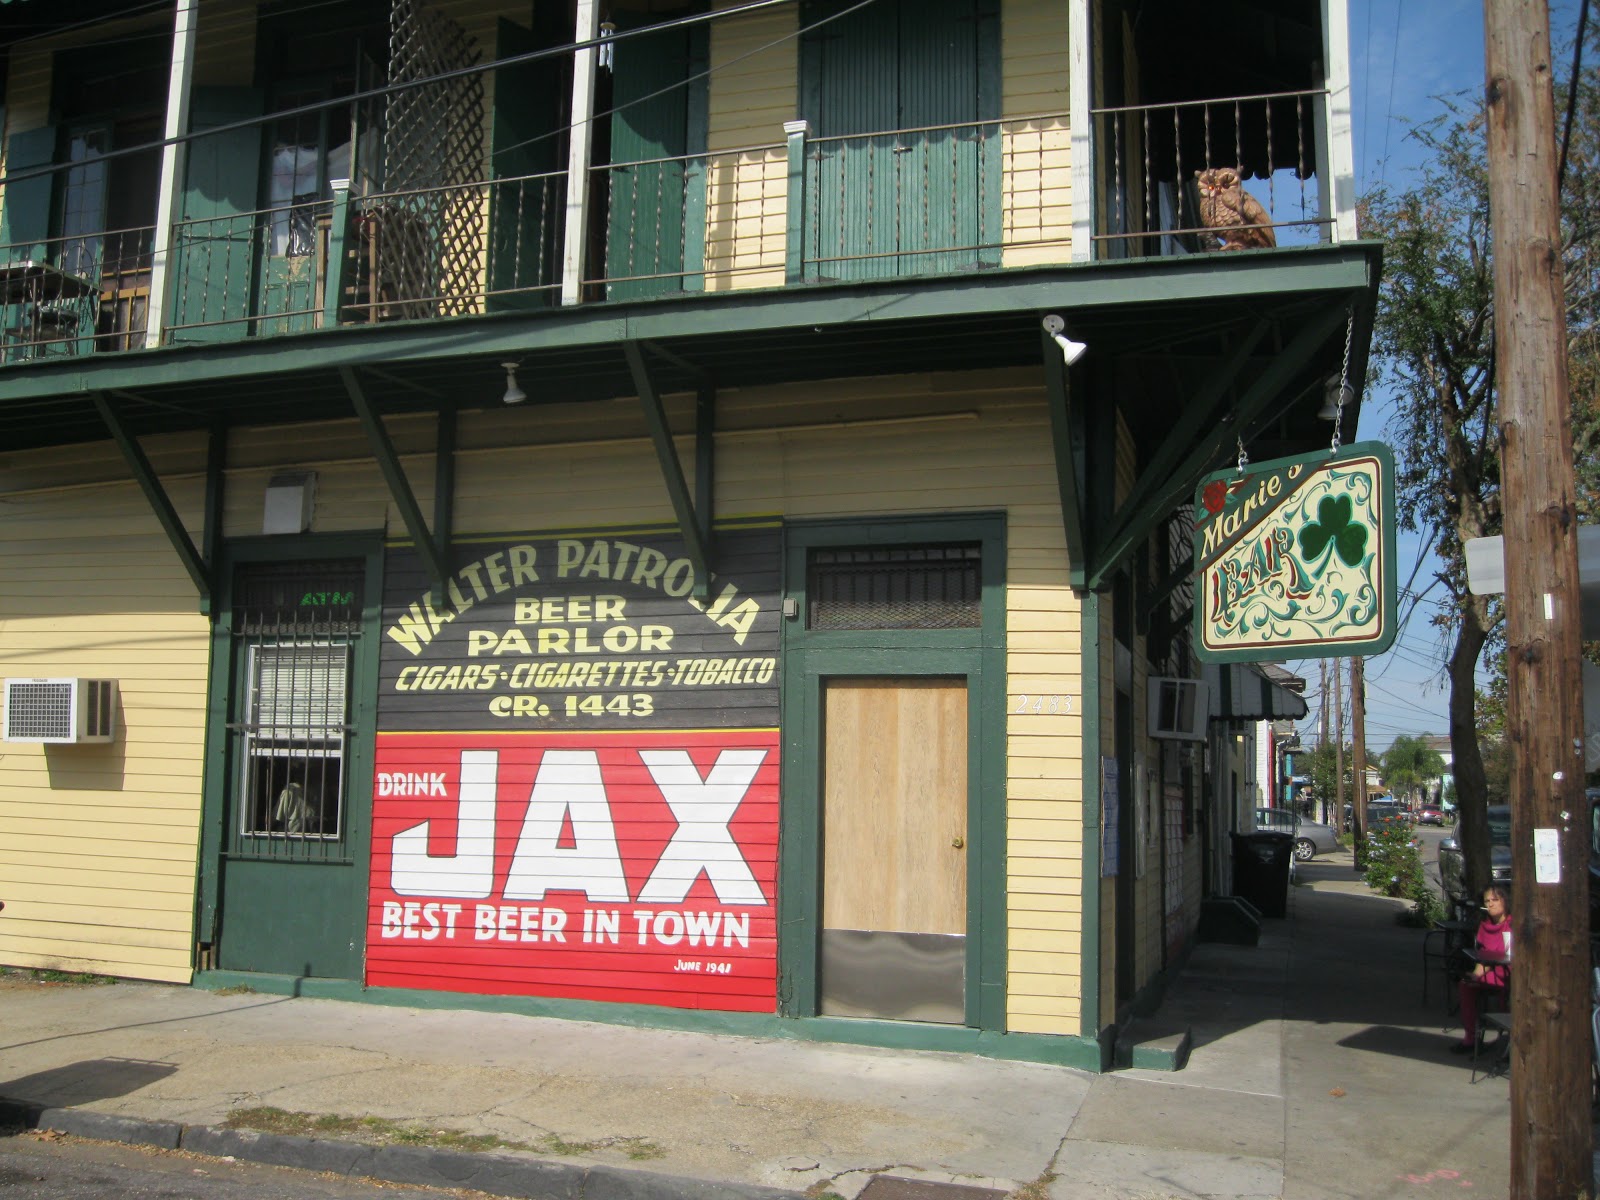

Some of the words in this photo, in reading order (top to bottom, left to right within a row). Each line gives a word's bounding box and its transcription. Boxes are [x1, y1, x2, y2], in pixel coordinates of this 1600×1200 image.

[1210, 526, 1316, 627] BAR
[386, 544, 538, 656] WALTER
[514, 594, 627, 625] BEER
[467, 625, 674, 656] PARLOR
[488, 695, 550, 717] CR.
[564, 693, 655, 717] 1443
[1015, 694, 1073, 714] 2483
[377, 772, 447, 797] DRINK
[391, 749, 770, 905] JAX
[381, 901, 462, 940] BEST
[474, 905, 567, 943] BEER
[582, 909, 620, 945] IN
[633, 910, 750, 949] TOWN
[674, 959, 701, 971] JUNE
